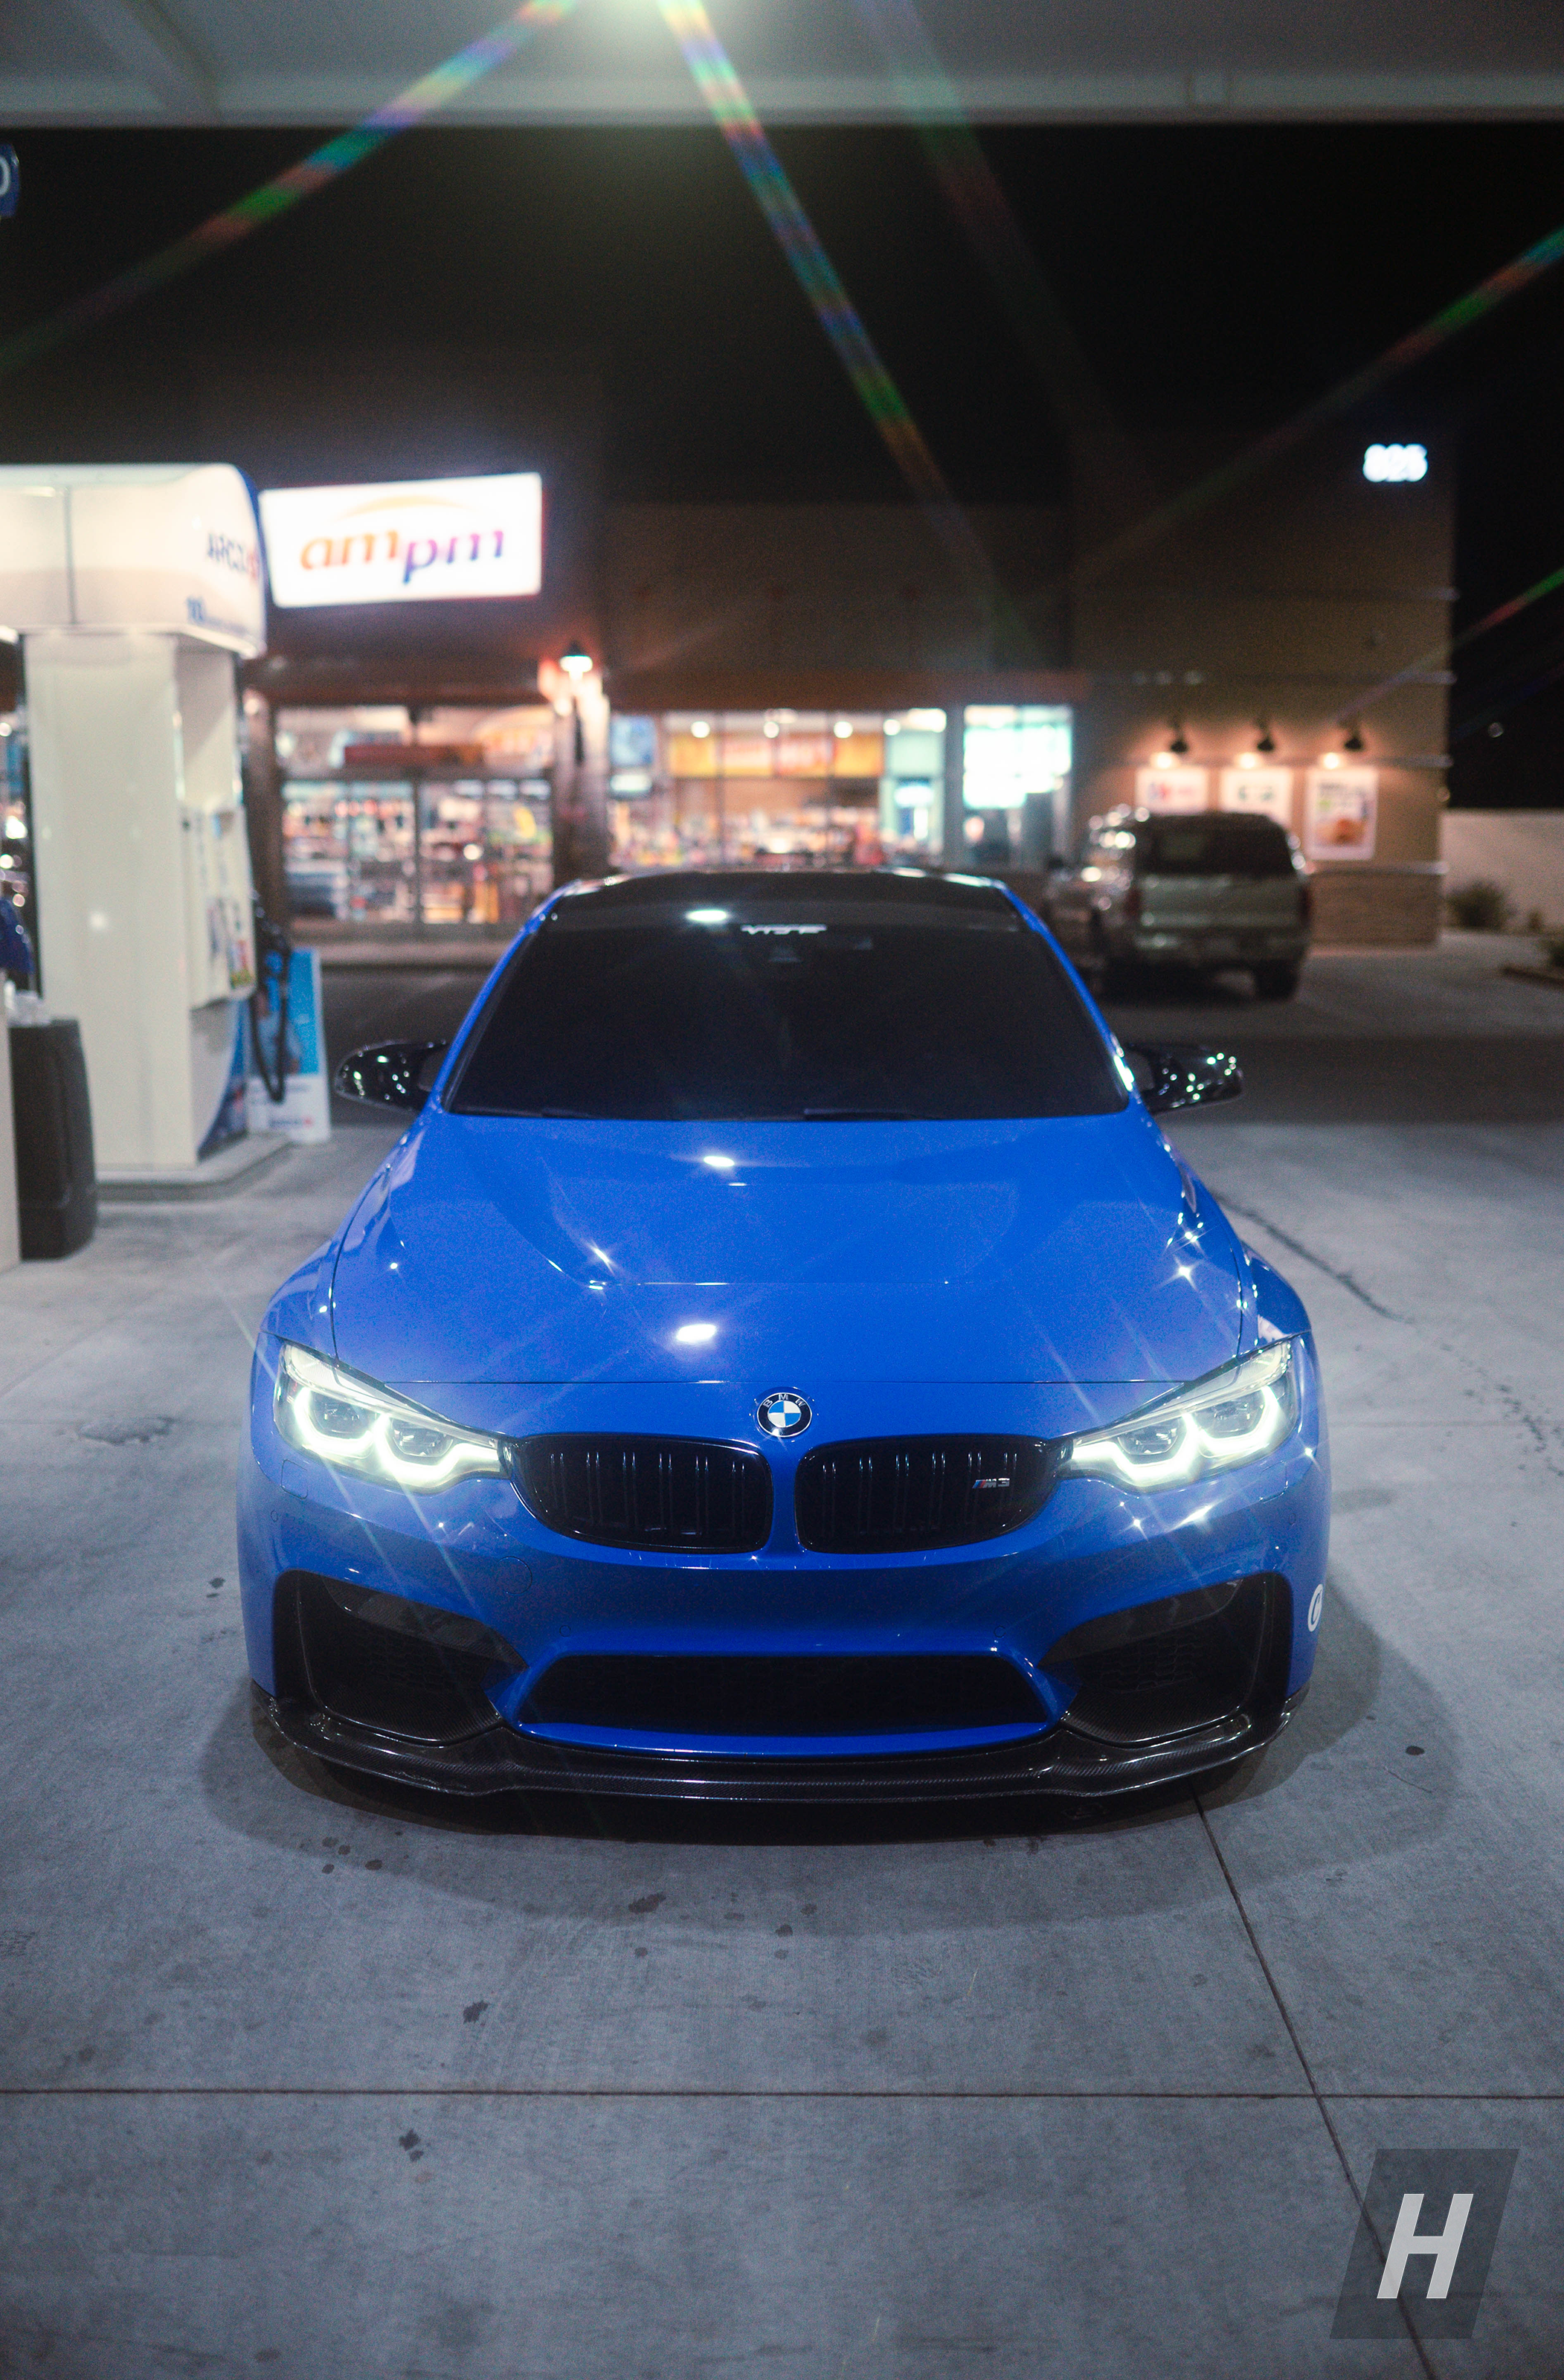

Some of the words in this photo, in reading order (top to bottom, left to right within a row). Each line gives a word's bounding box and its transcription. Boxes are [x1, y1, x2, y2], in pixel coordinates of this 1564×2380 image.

[300, 530, 504, 585] ampm
[762, 1393, 806, 1408] BMW
[982, 1477, 1011, 1488] M3
